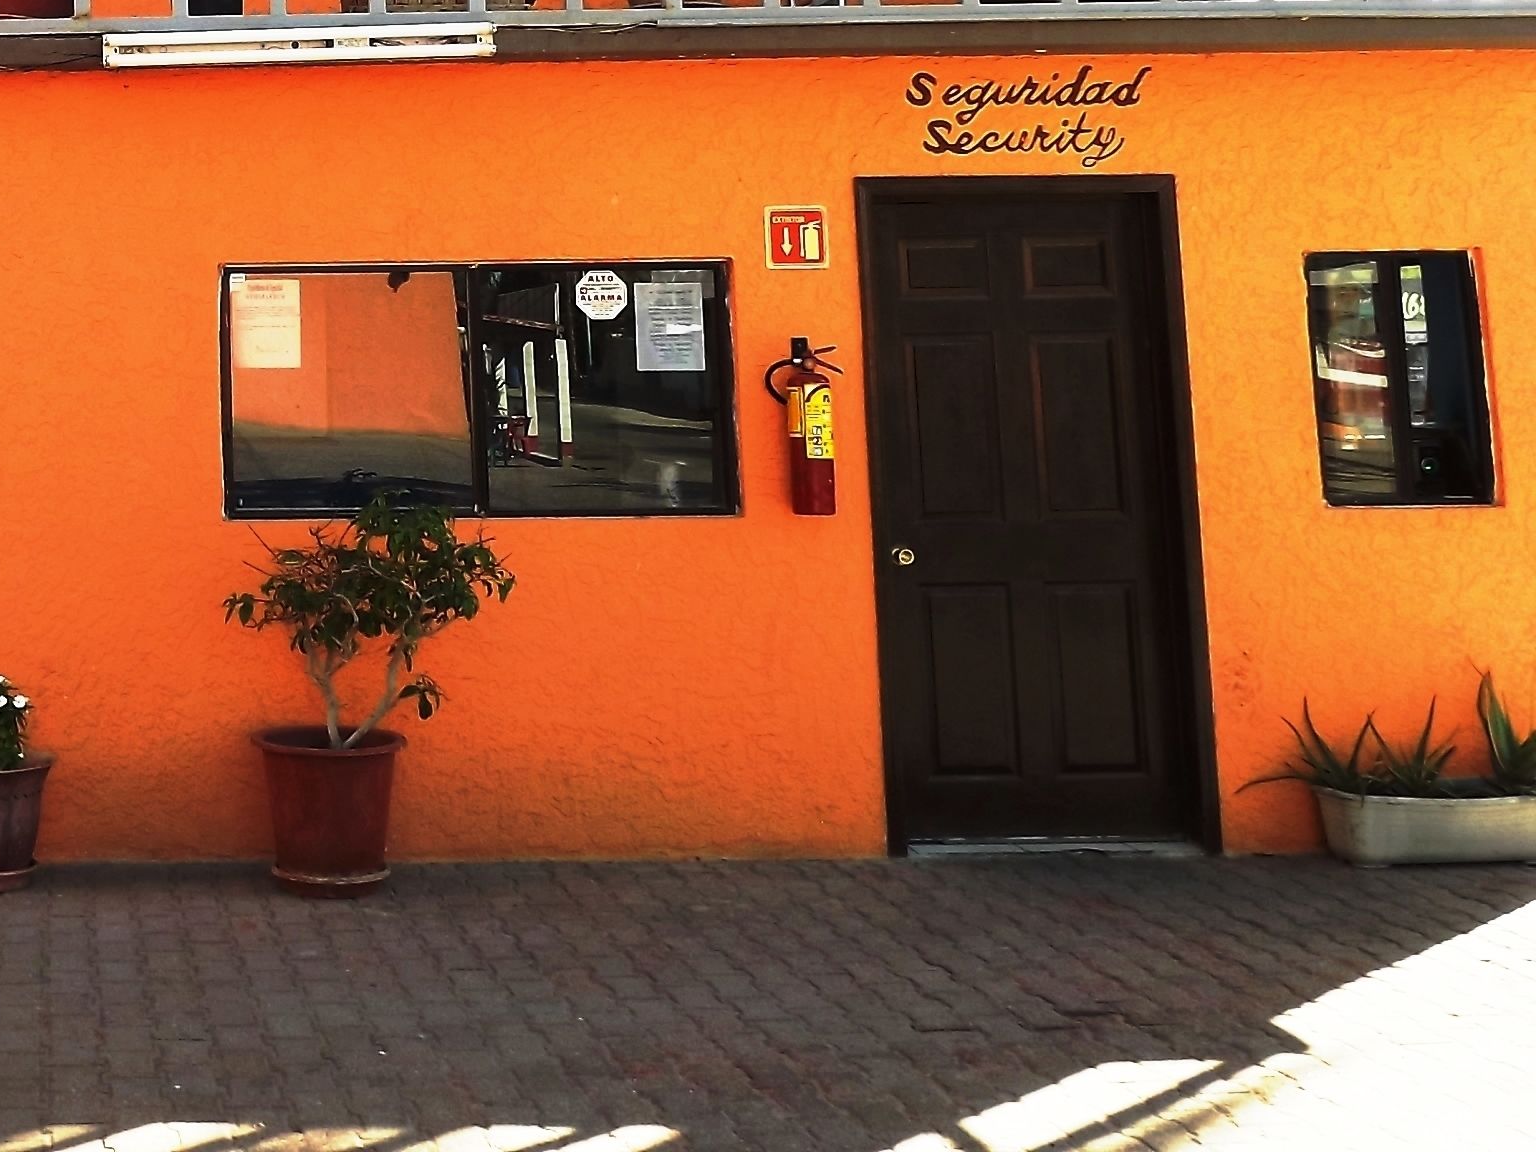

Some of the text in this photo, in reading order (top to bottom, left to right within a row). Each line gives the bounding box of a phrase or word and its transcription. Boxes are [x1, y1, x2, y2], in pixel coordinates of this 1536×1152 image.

[906, 65, 1152, 125] Seguridad
[923, 112, 1125, 168] Security
[580, 294, 623, 302] ALARMA
